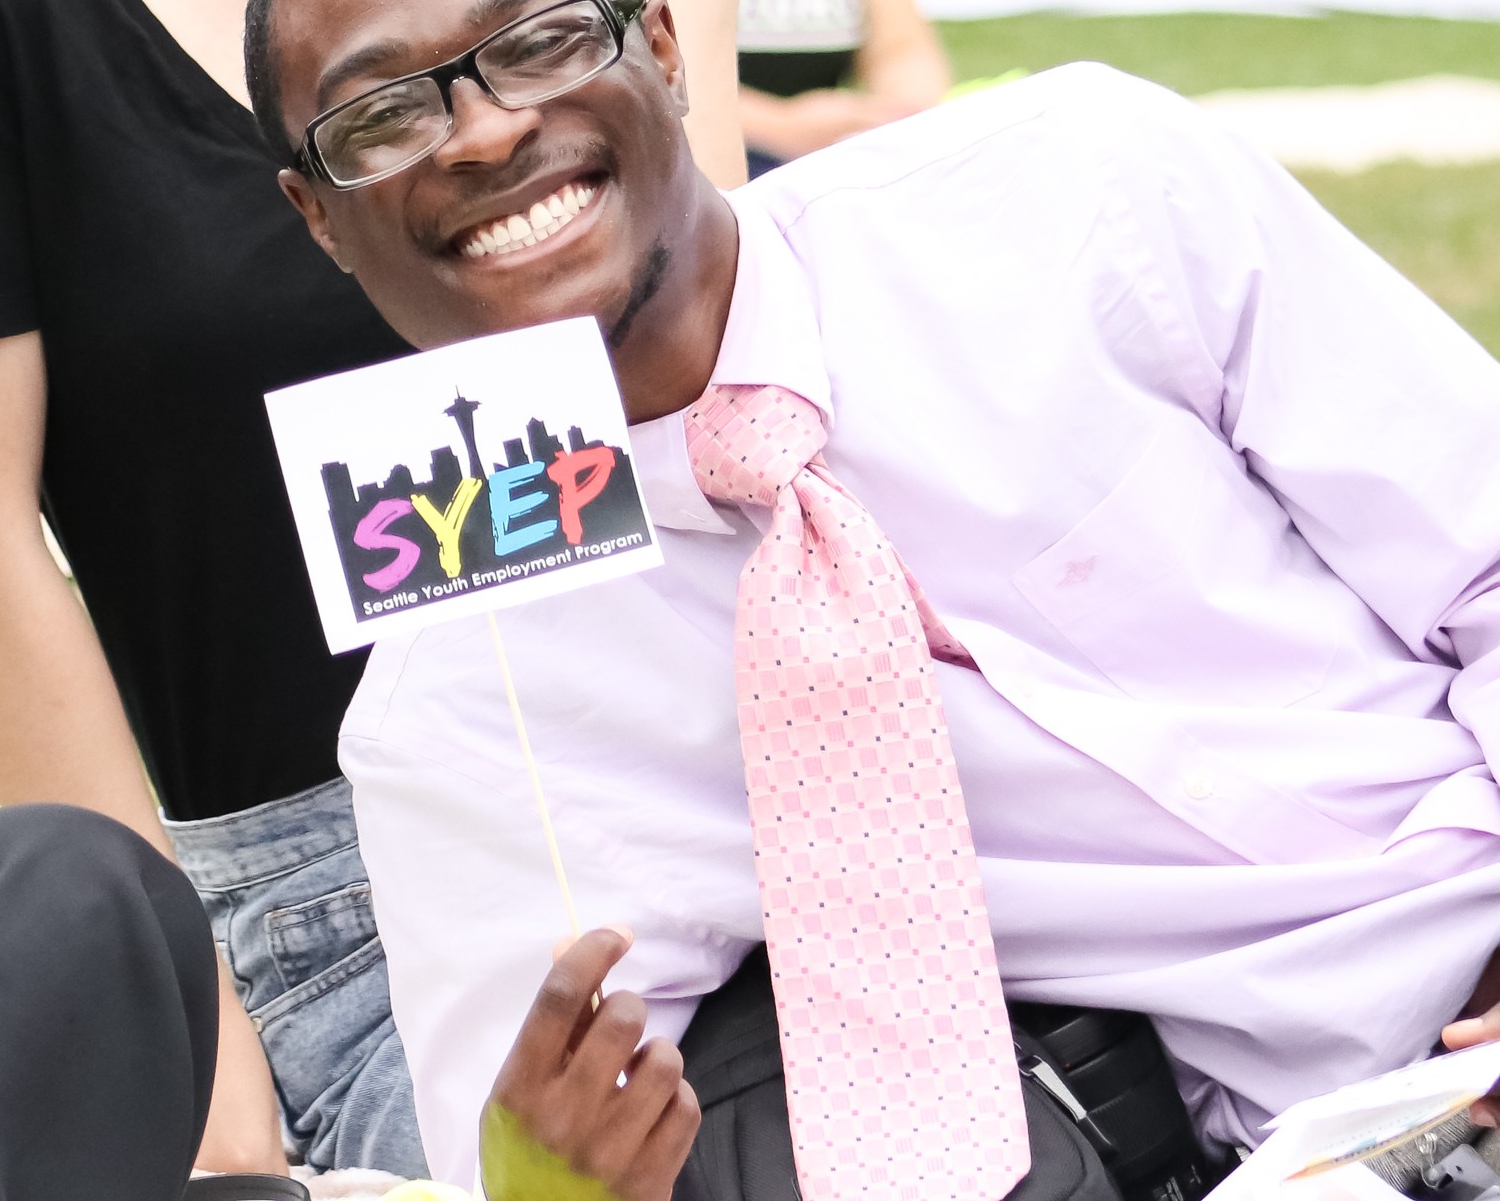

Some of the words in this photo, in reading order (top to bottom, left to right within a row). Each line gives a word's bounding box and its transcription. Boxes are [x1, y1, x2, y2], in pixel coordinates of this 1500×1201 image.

[353, 446, 616, 593] SYEP
[362, 589, 419, 616] Seattle
[421, 576, 469, 600] Youth
[471, 549, 572, 587] Employment
[574, 532, 644, 560] Program
